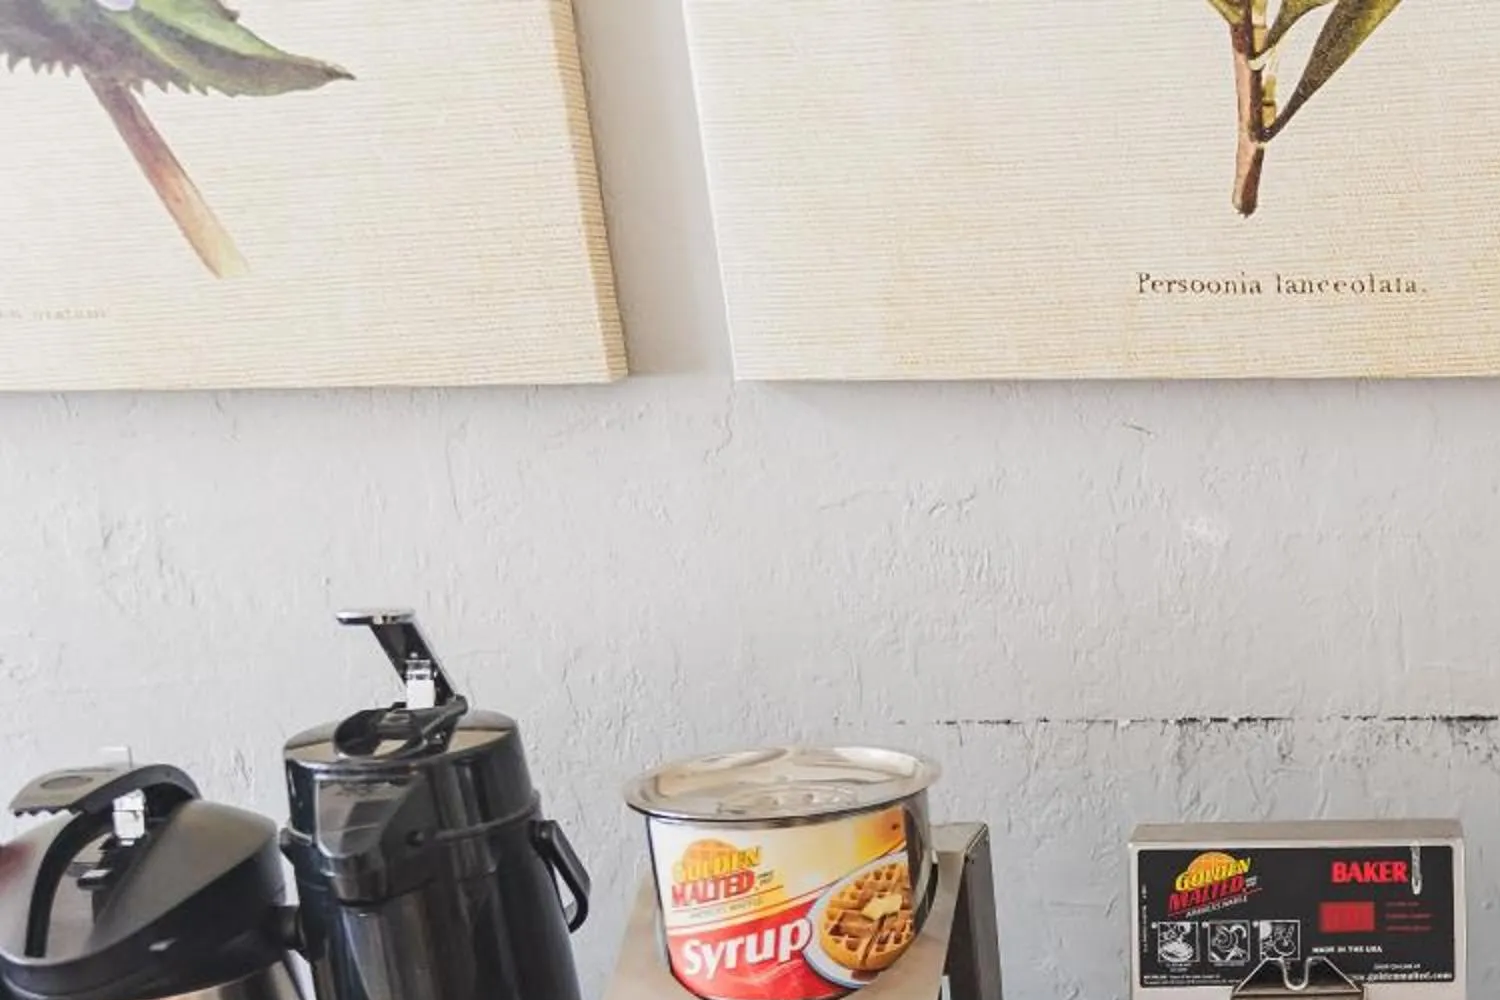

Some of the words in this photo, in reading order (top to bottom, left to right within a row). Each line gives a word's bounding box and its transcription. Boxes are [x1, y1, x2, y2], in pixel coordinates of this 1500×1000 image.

[1136, 271, 1262, 294] Persoonia
[1331, 861, 1409, 884] BAKER
[672, 870, 755, 907] MALTED
[682, 918, 812, 980] Syrup
